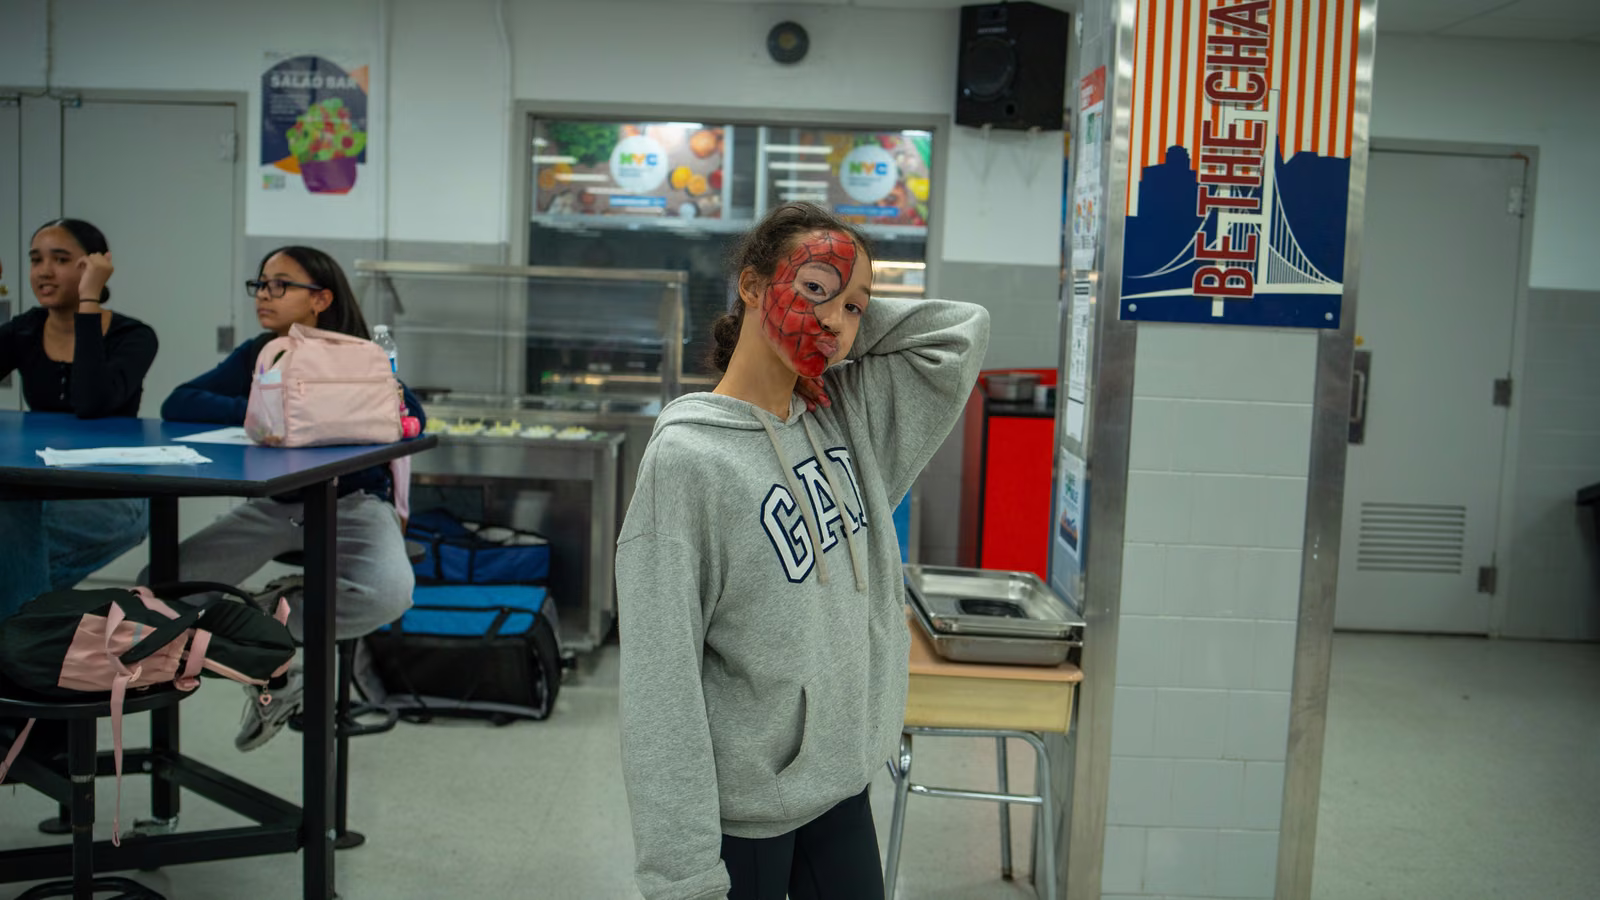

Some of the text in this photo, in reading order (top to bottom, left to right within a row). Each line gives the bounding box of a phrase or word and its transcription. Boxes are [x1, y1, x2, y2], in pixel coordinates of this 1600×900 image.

[270, 75, 358, 89] SALAD BAR
[1192, 0, 1272, 298] BE THE CHA
[620, 153, 658, 167] NYC
[849, 162, 887, 176] NYC
